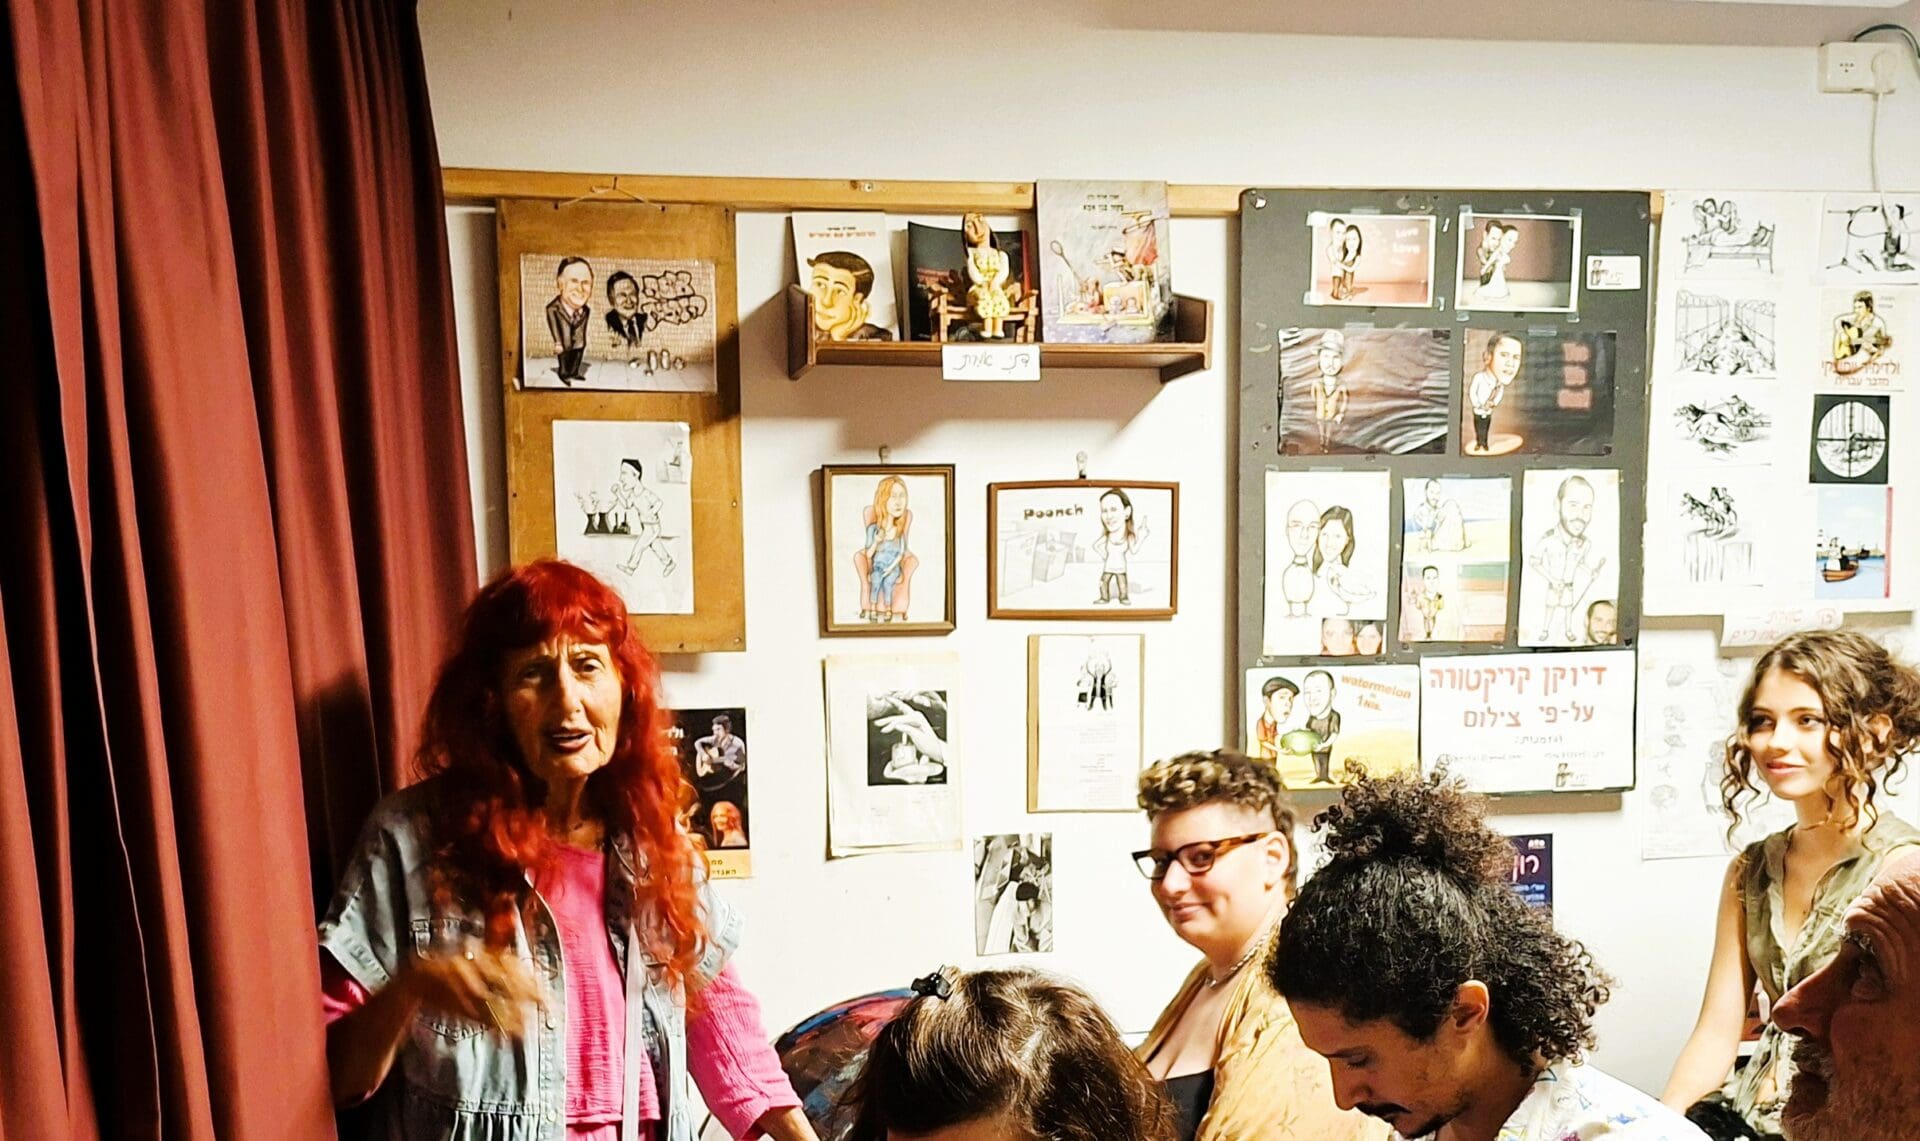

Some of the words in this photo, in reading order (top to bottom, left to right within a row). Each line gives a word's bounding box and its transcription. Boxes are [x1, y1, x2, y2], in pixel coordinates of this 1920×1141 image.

[1341, 675, 1412, 699] watermelon
[1429, 666, 1531, 703] קריקטורה
[1543, 666, 1607, 696] דיוקן
[1463, 706, 1522, 728] צילום
[1538, 701, 1595, 724] על-פי
